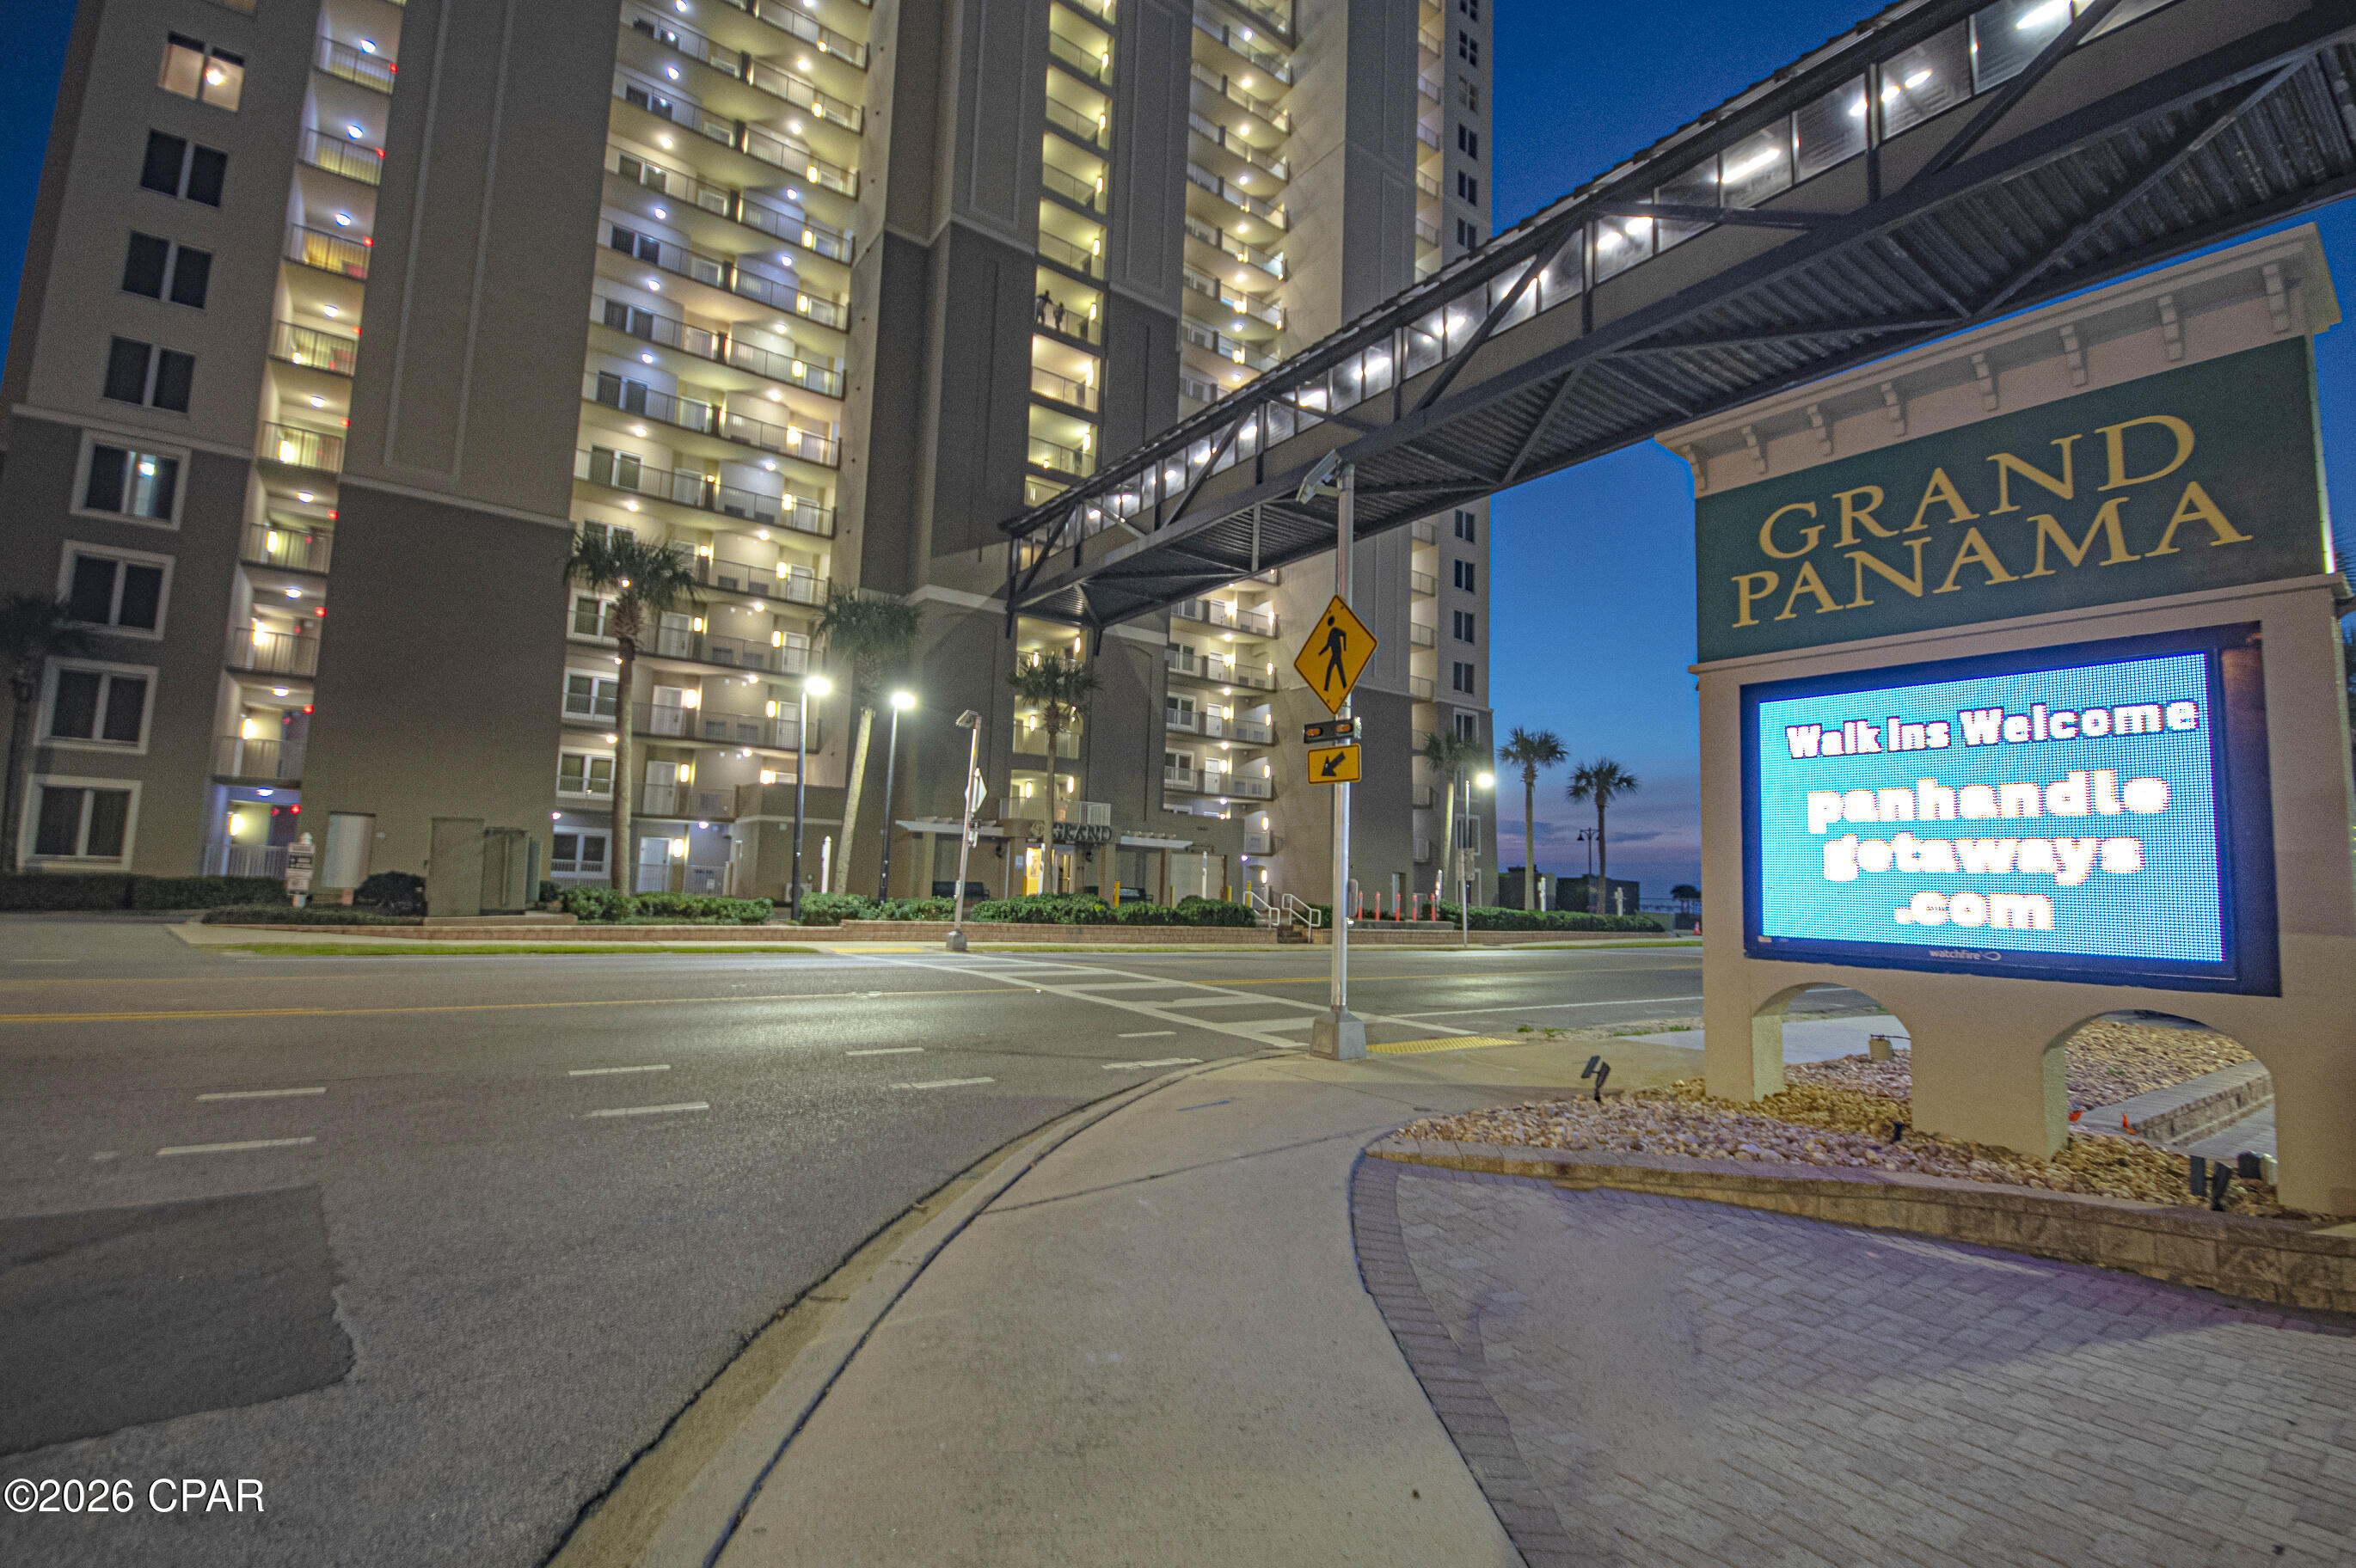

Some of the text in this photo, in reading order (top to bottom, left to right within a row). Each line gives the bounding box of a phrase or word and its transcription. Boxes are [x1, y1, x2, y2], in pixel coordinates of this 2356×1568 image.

[1758, 415, 2195, 559] GRAND
[1732, 481, 2253, 628] PANAMA
[1785, 699, 2200, 759] Walk Ins Welcome
[1807, 769, 2172, 834] panhandle
[1053, 822, 1113, 842] GRAND
[1822, 831, 2145, 886] getaways
[1893, 891, 2056, 930] .com
[1929, 949, 1982, 960] watchfire
